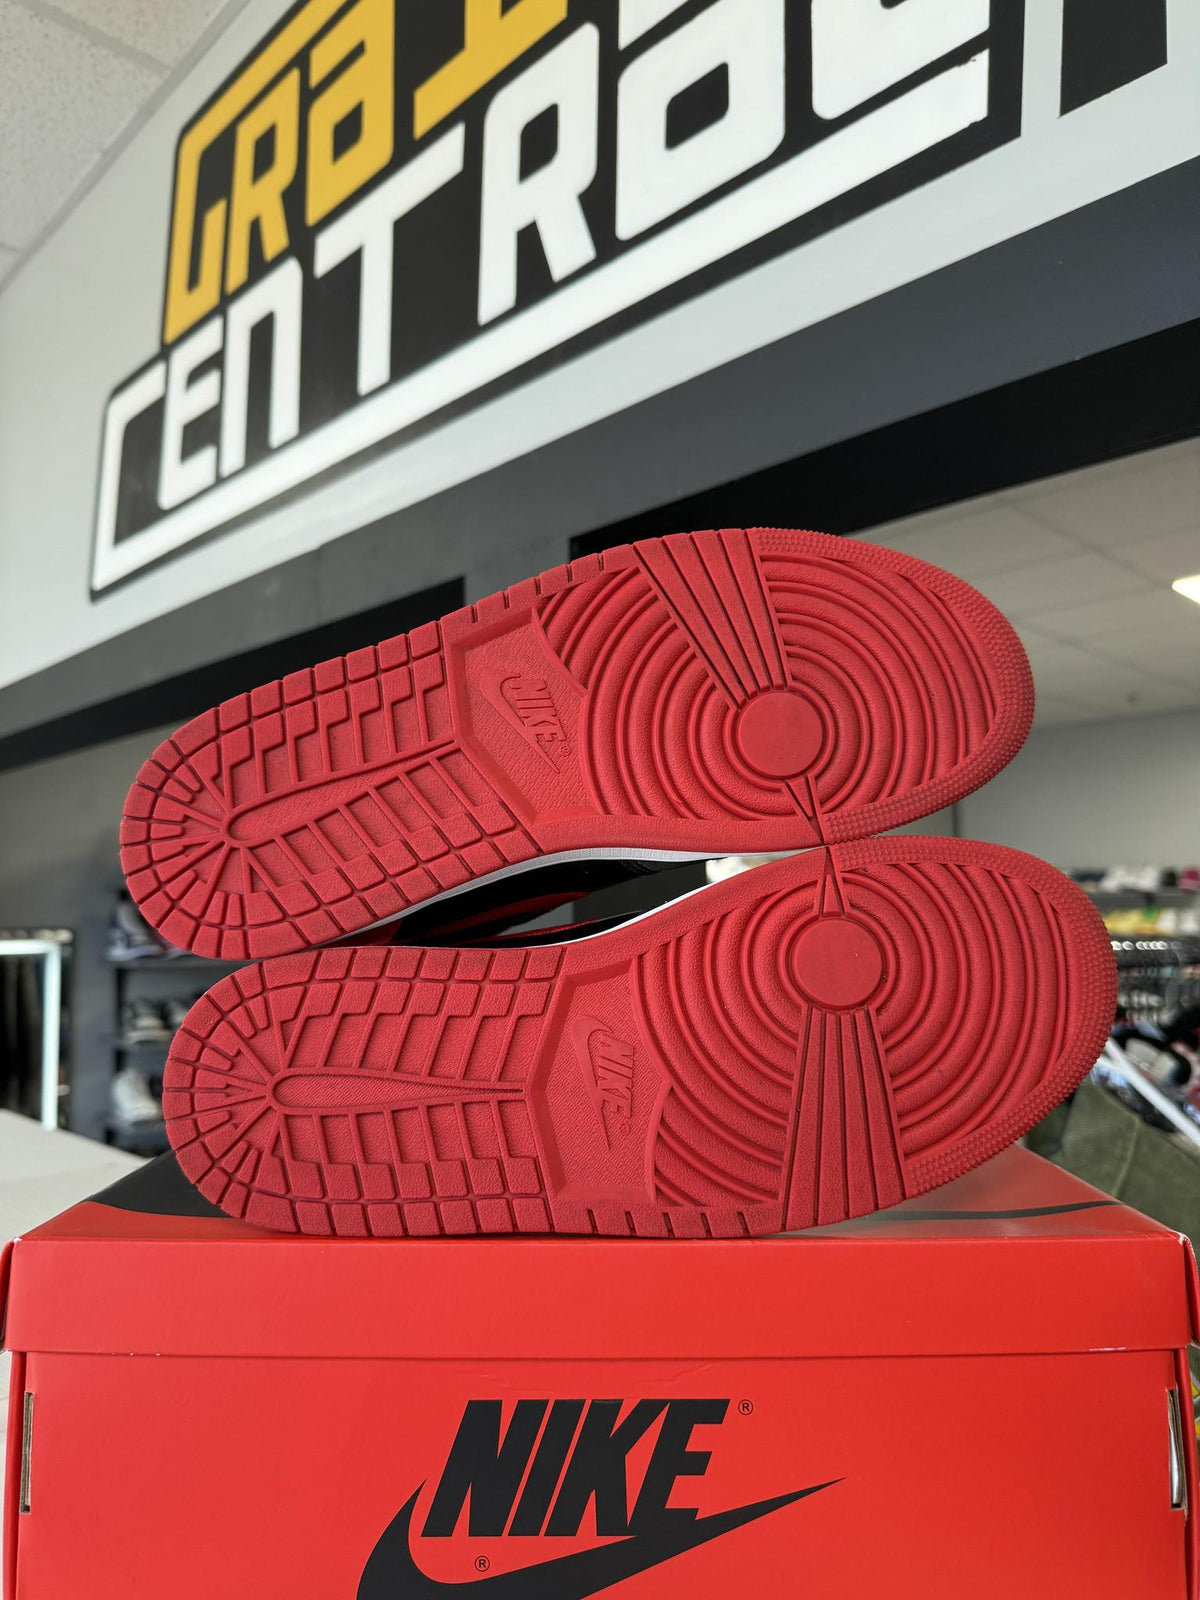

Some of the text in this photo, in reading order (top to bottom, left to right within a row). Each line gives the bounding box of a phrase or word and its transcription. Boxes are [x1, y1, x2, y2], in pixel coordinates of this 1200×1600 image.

[510, 678, 568, 743] NIKE
[598, 1032, 636, 1120] NIKE
[420, 1397, 731, 1538] NIKE
